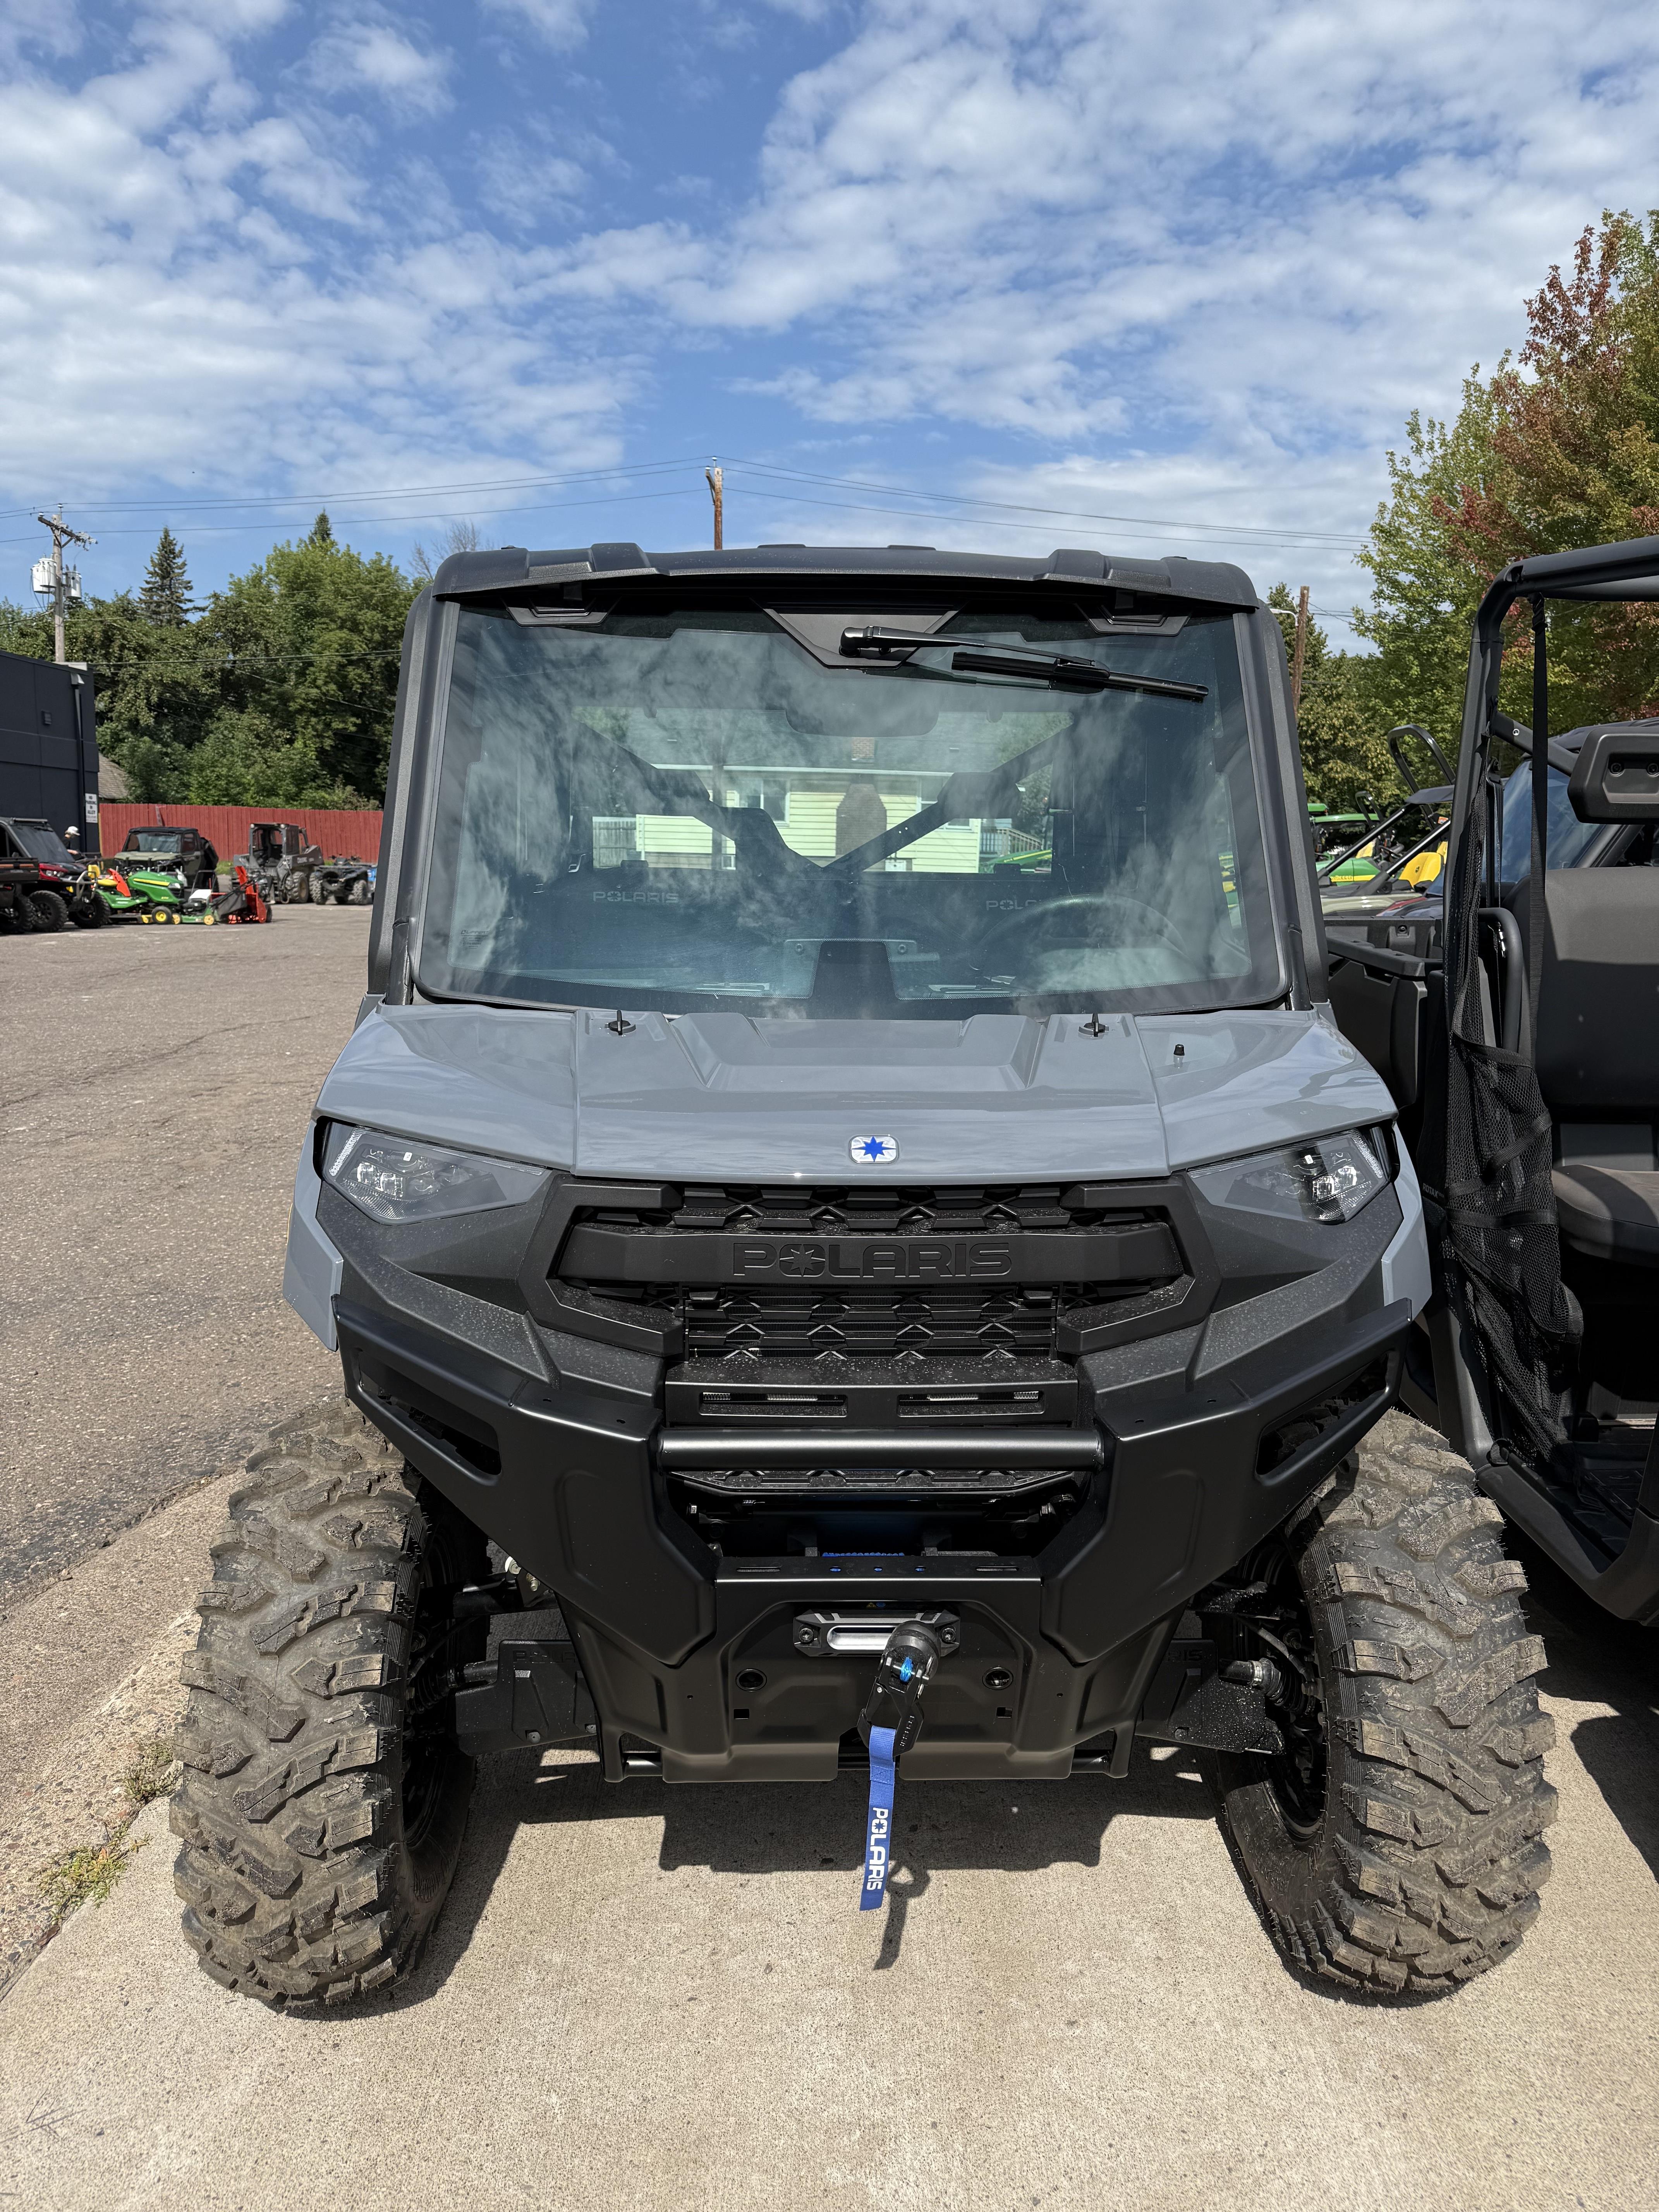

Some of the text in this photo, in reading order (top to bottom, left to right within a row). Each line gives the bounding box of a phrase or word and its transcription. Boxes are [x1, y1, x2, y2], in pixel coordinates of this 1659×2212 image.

[593, 891, 679, 903] POLARIS
[1422, 1183, 1438, 1199] ROTAX
[733, 1242, 1012, 1278] POLARIS
[867, 1807, 888, 1890] POLARIS
